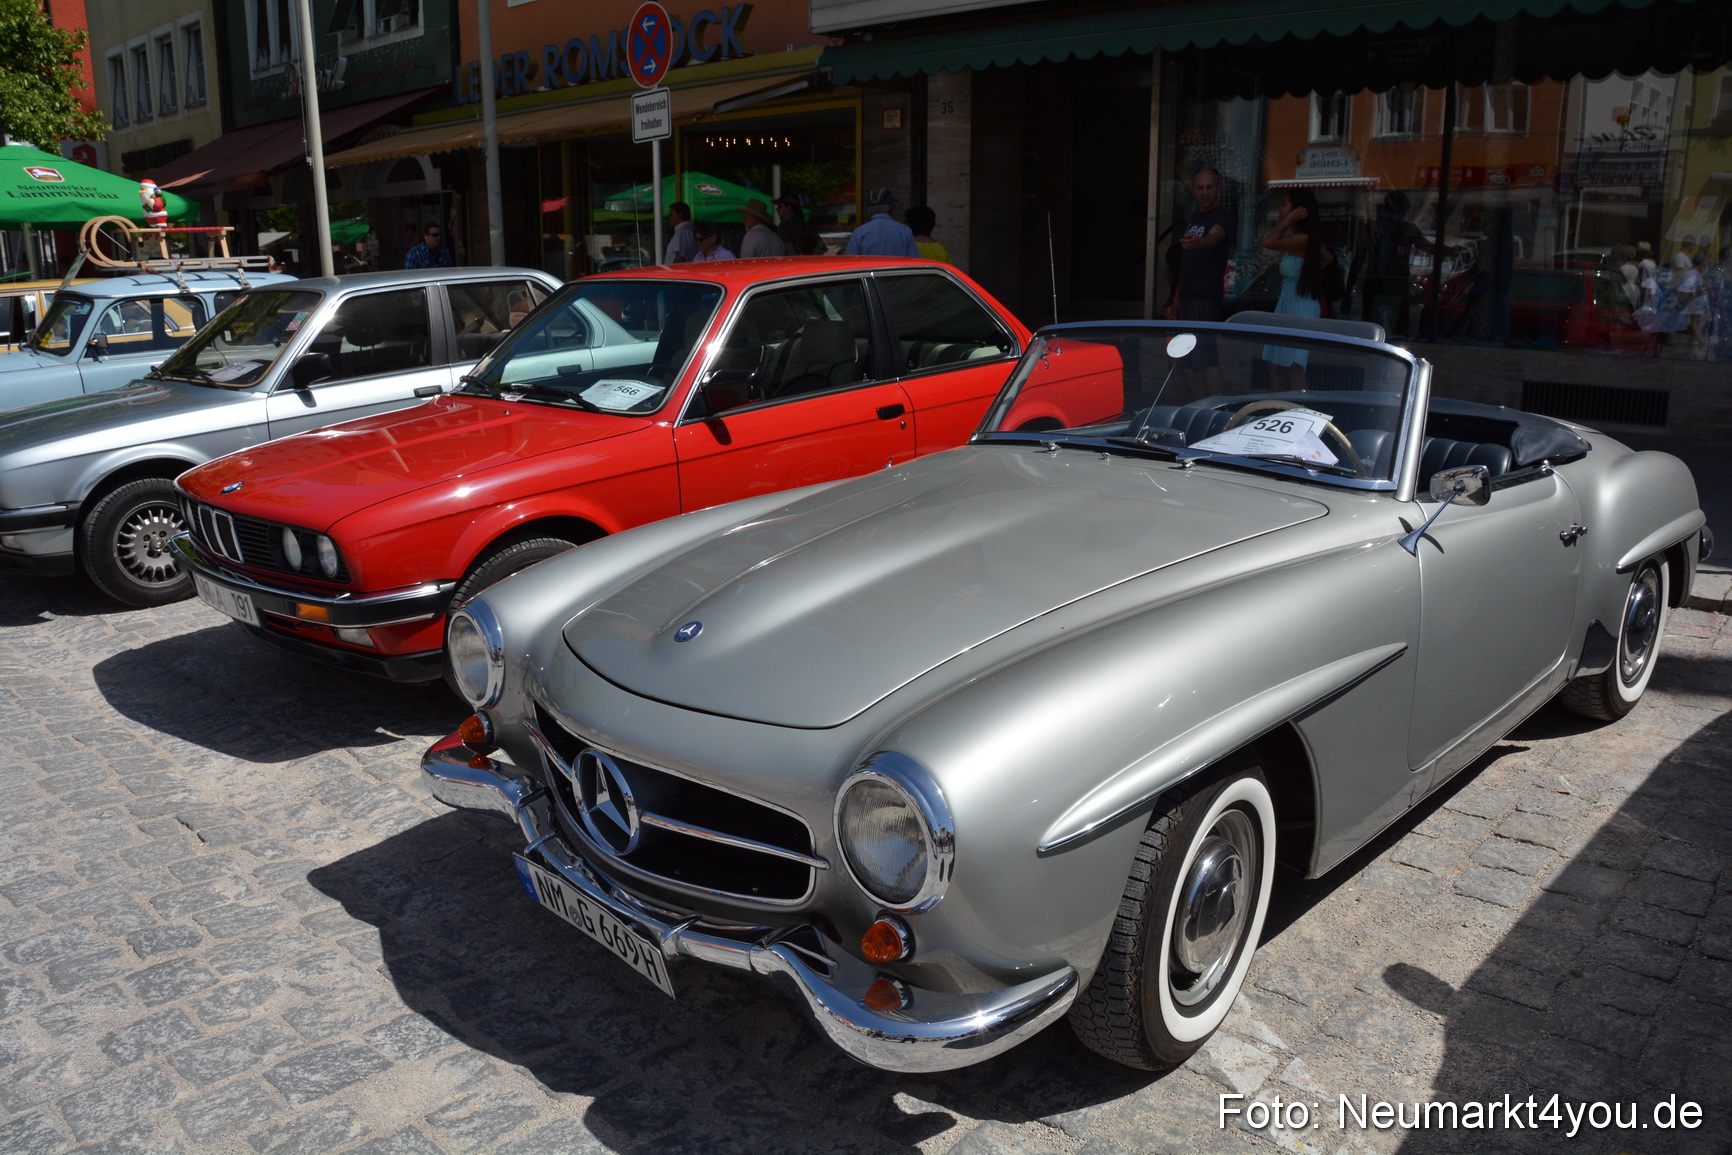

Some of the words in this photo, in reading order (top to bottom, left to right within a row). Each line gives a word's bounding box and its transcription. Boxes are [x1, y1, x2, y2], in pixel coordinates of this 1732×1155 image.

[635, 98, 667, 114] Wendebereich
[941, 101, 954, 114] 35
[640, 118, 662, 130] freihalten
[6, 190, 119, 199] Lammsbräu
[614, 385, 640, 396] 566
[1254, 419, 1295, 434] 526
[230, 592, 253, 621] 191
[535, 871, 569, 918] NM
[600, 914, 662, 984] 669H
